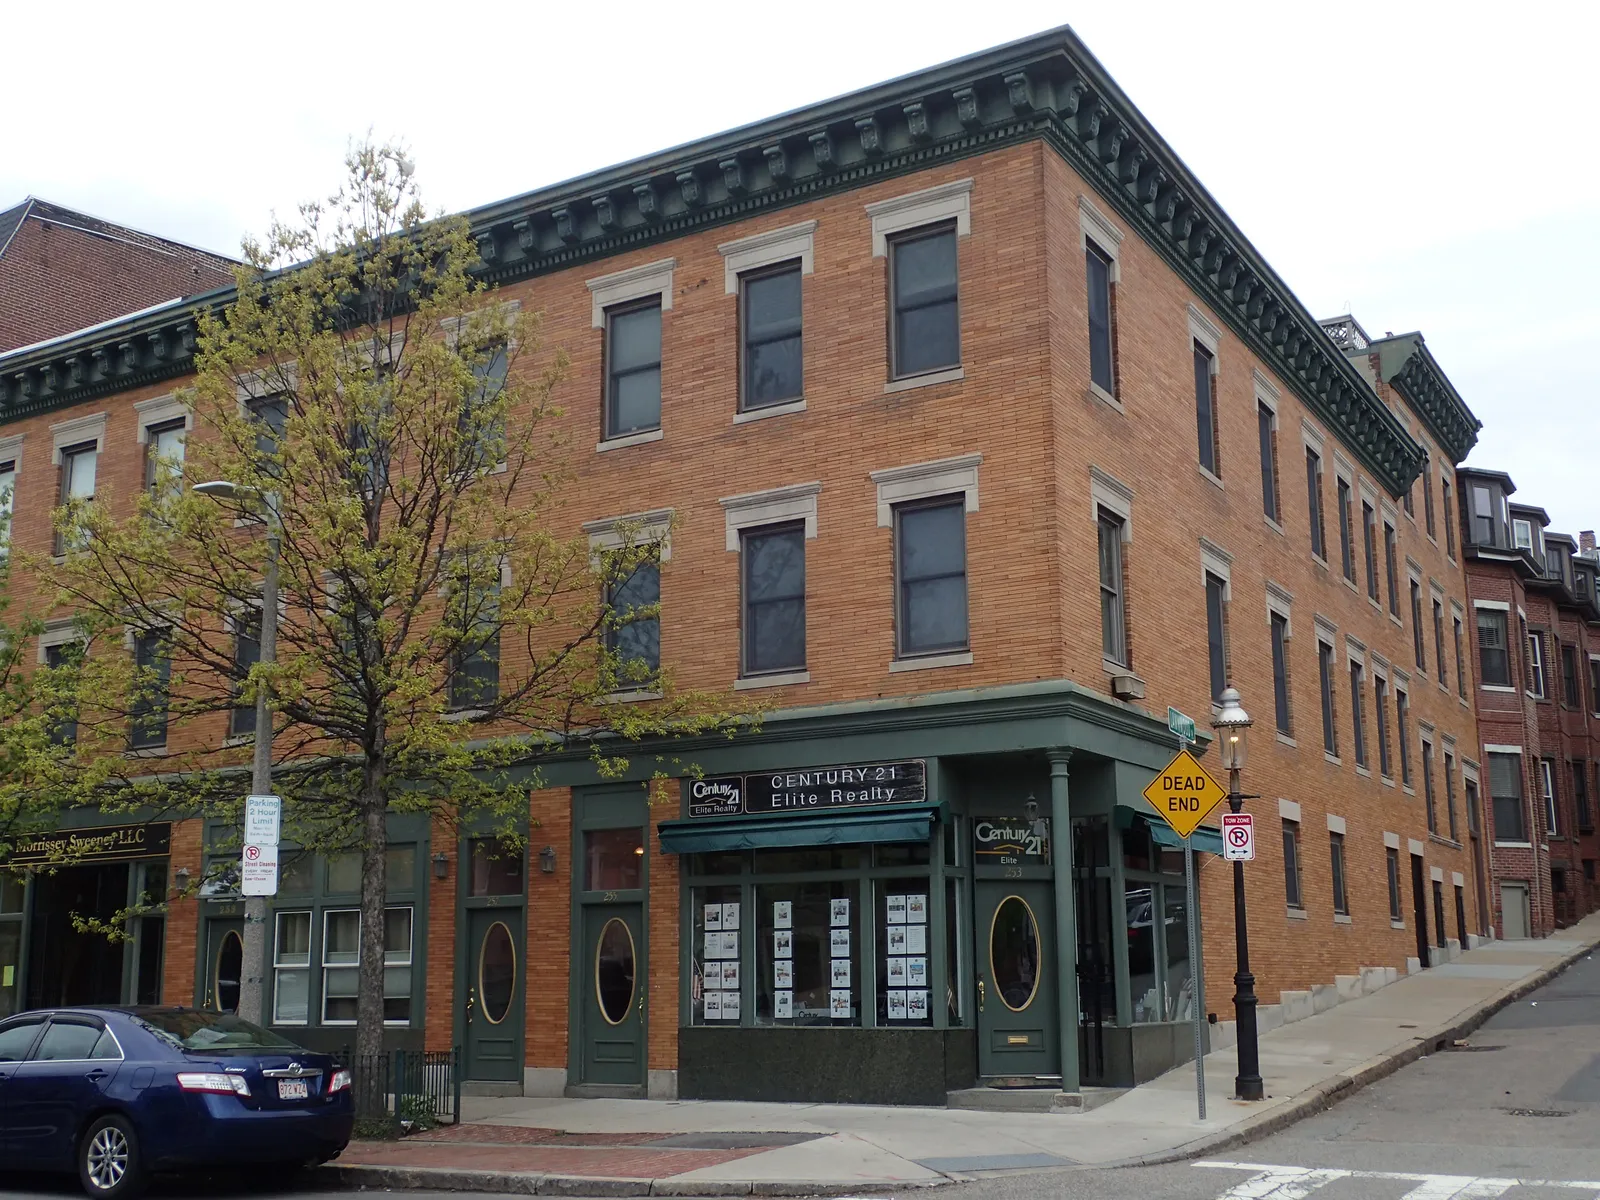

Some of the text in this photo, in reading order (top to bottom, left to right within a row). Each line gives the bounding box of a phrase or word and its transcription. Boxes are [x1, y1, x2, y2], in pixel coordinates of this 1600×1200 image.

[771, 766, 896, 789] CENTURY 21
[1163, 776, 1205, 790] DEAD
[693, 781, 740, 805] Century 21
[771, 786, 895, 808] Elite Realty
[249, 800, 278, 809] Parking
[713, 804, 738, 813] Realty
[1168, 797, 1200, 811] END
[257, 808, 277, 816] Hour
[252, 817, 273, 825] Limit
[975, 822, 1031, 843] Century
[16, 828, 146, 852] Morrissey Sweeney LLC
[1025, 836, 1041, 854] 21
[1000, 856, 1018, 864] Elite
[1005, 866, 1023, 878] 253
[603, 892, 618, 903] 255
